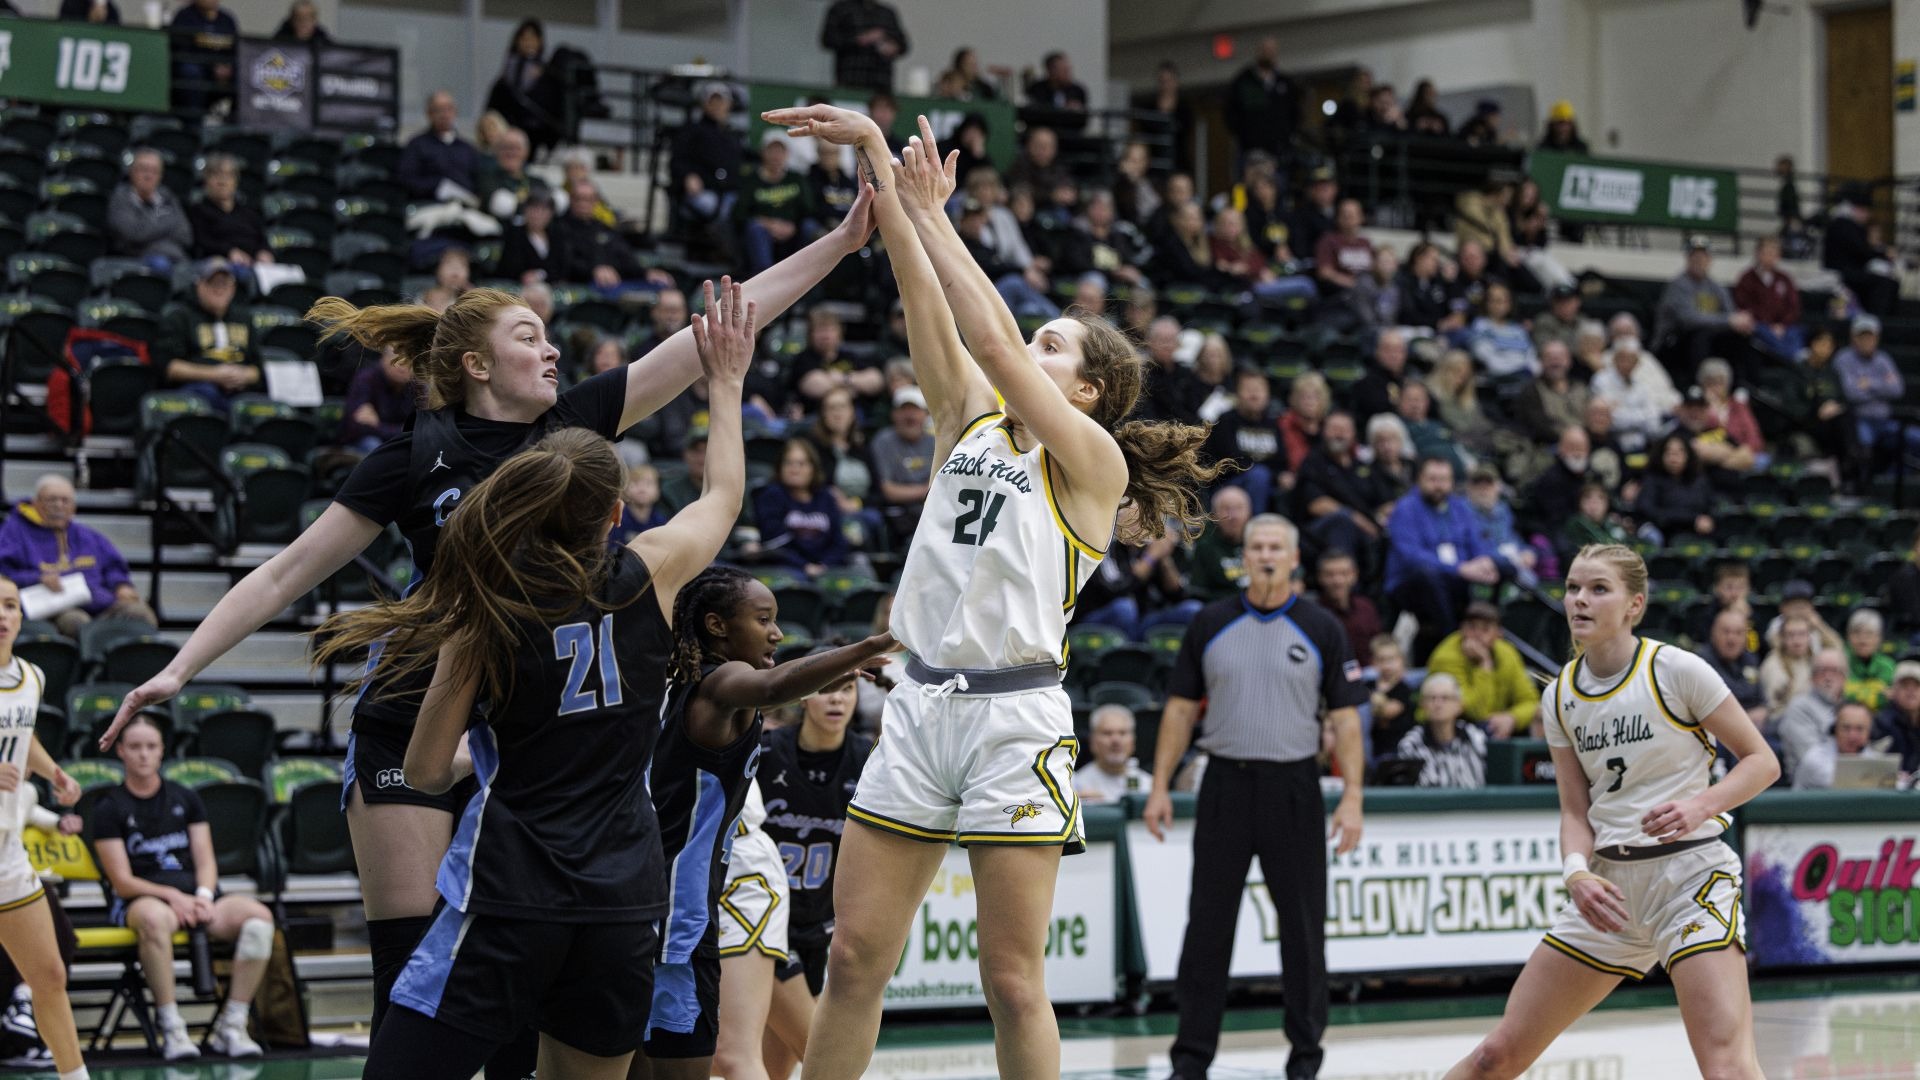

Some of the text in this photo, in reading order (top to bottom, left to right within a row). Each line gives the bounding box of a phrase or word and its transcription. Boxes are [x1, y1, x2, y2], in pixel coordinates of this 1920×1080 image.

[56, 37, 131, 93] 103
[552, 613, 623, 717] 21
[1574, 714, 1654, 754] Black Hills
[376, 768, 414, 789] CC
[24, 840, 82, 865] HSU
[778, 841, 834, 890] 20
[1396, 842, 1479, 866] HILLS
[1493, 839, 1558, 862] STAT
[1792, 838, 1920, 902] Quik
[1433, 873, 1570, 933] JACKE
